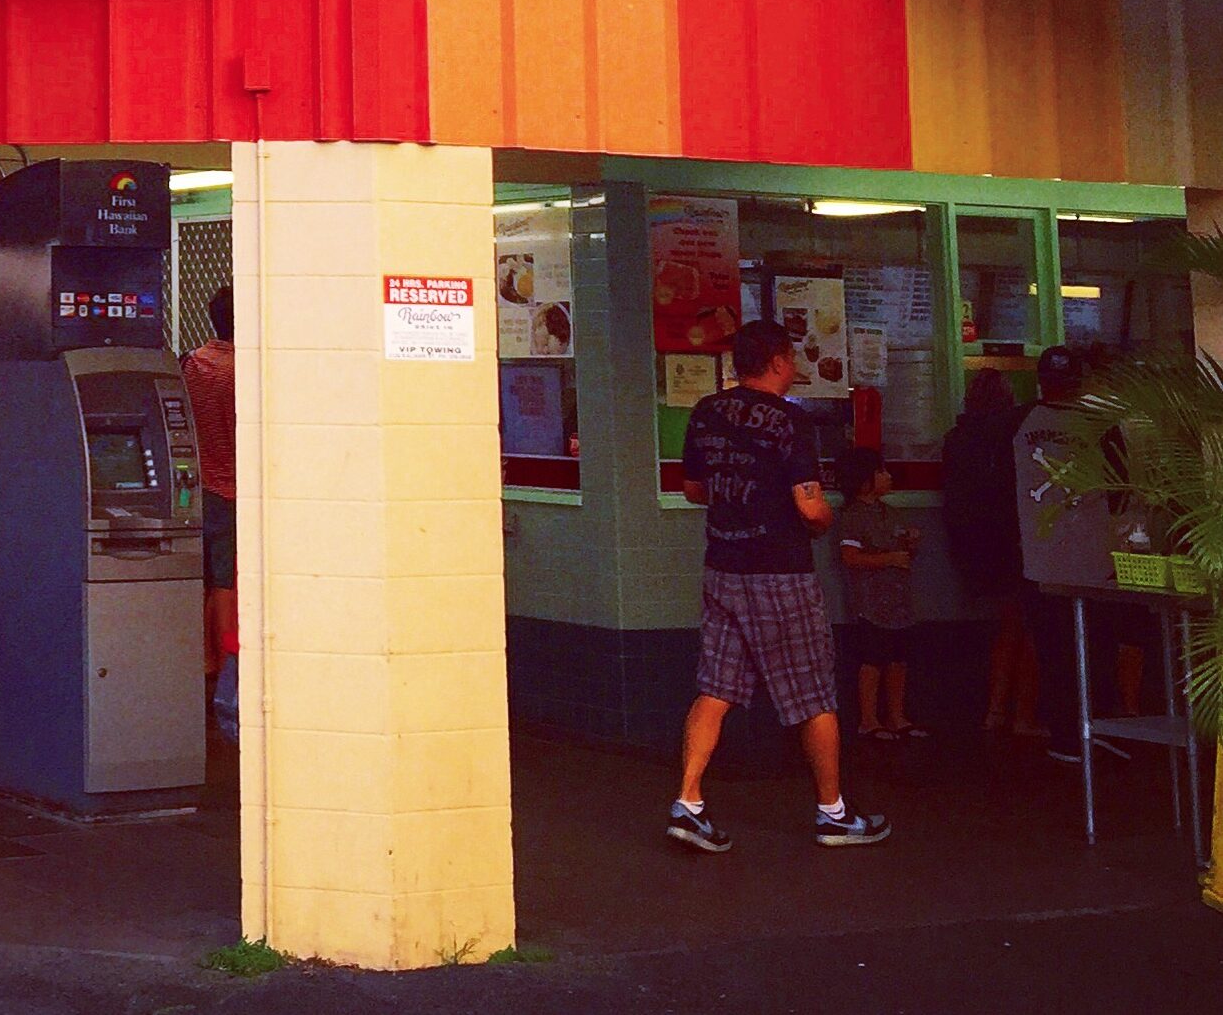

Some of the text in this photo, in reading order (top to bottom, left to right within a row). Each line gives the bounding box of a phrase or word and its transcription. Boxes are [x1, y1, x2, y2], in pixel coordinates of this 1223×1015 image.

[112, 195, 137, 207] First
[97, 208, 148, 222] Hawaiian
[109, 223, 138, 235] Bank
[427, 280, 467, 289] PARKING
[389, 288, 467, 304] RESERVED
[397, 306, 461, 325] Rainbow
[420, 346, 462, 354] TOWING
